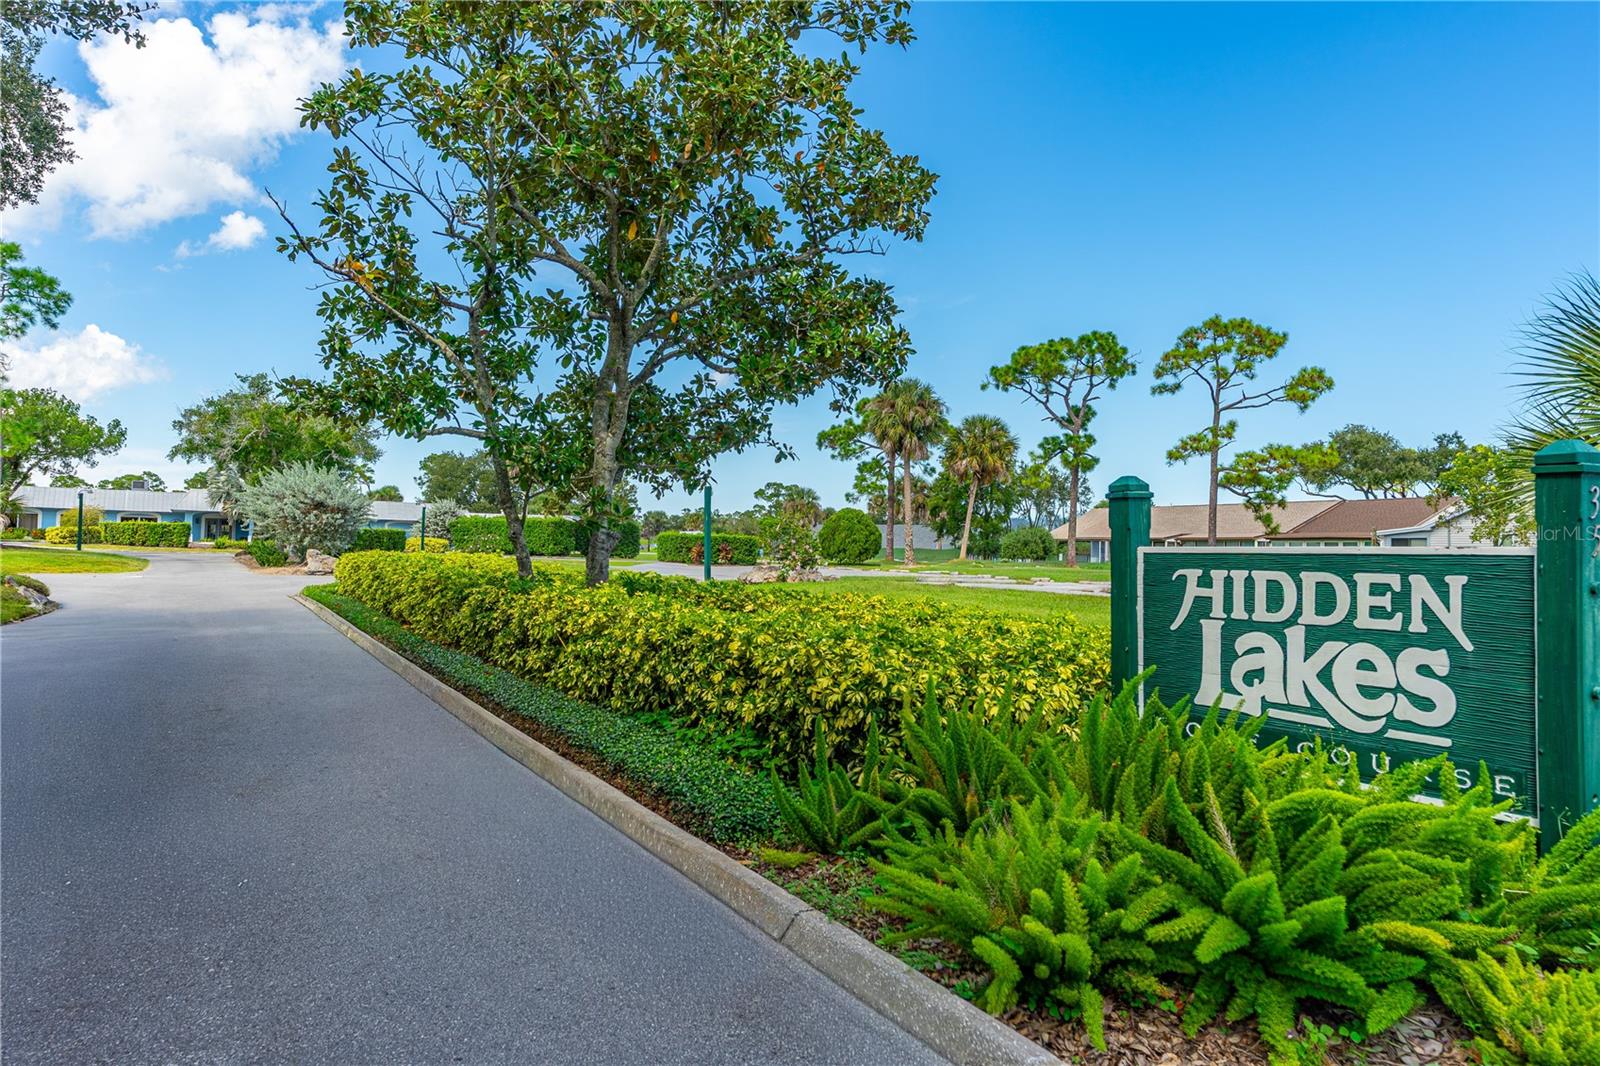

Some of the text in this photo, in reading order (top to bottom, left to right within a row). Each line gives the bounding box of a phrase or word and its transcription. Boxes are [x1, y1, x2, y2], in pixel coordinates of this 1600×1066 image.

[1170, 568, 1474, 652] HIDDEN
[1194, 618, 1457, 734] Lakes
[1296, 741, 1516, 798] COUSE
